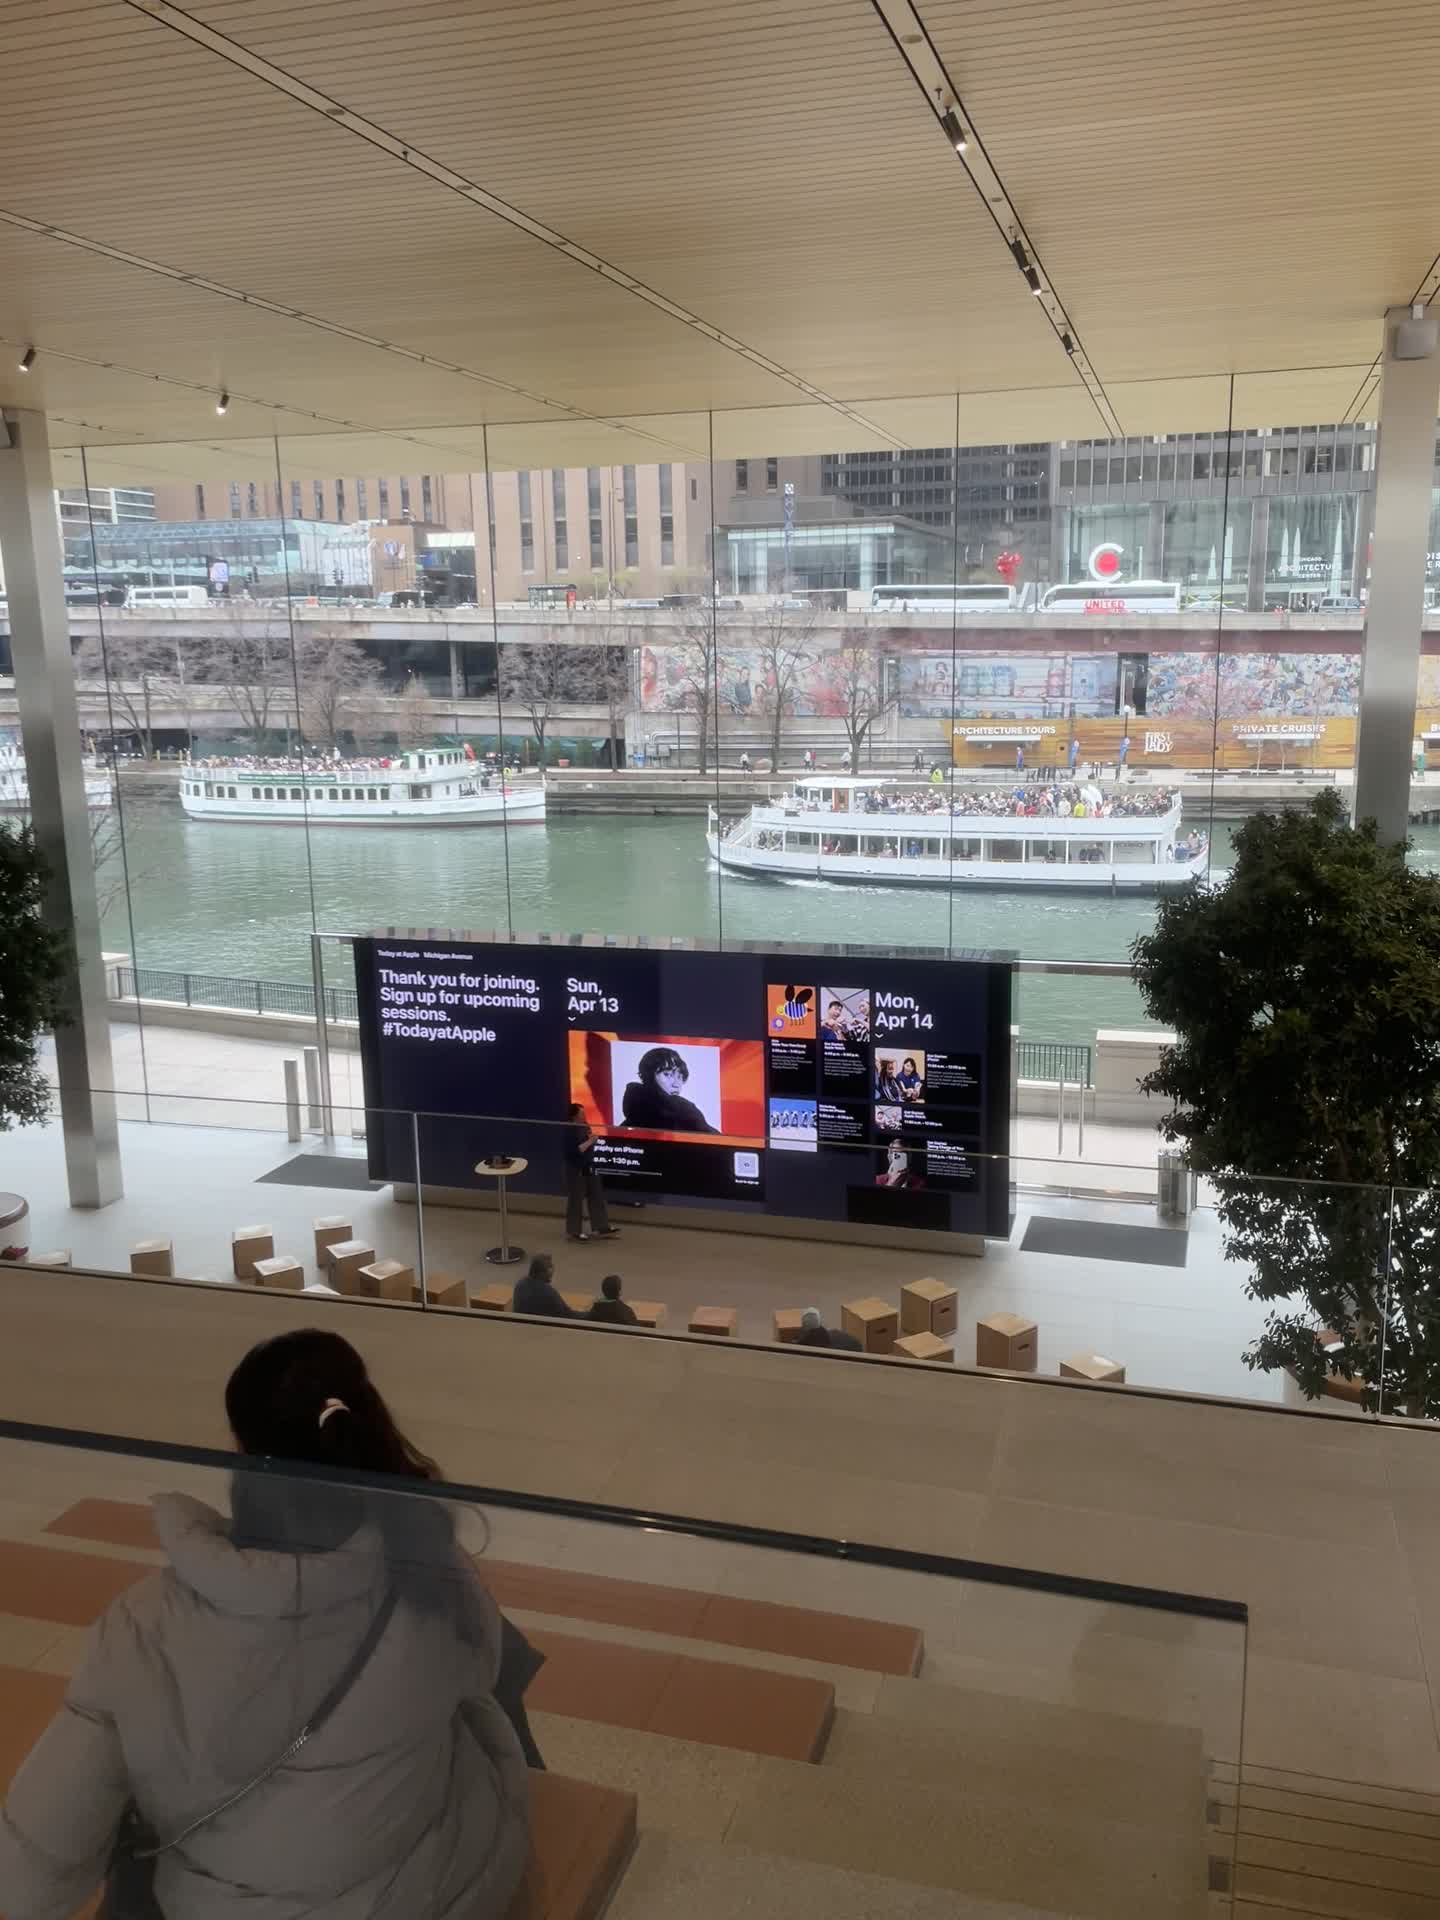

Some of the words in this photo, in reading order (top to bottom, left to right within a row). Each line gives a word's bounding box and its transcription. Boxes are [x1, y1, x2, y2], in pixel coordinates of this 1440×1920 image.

[1278, 563, 1334, 573] ARCHITECTU
[1085, 599, 1126, 609] UNITED
[953, 727, 1023, 735] ARCHITECTURE
[1026, 726, 1056, 735] TOURS
[1145, 731, 1171, 742] FIRST
[1232, 724, 1278, 733] PRIVATE
[1281, 724, 1327, 733] CRUISES
[1144, 741, 1174, 753] LADY
[379, 969, 427, 985] Thank
[428, 975, 457, 989] you
[459, 973, 481, 988] for
[483, 974, 540, 994] joining.
[567, 977, 603, 996] Sun,
[380, 987, 414, 1004] Sign
[417, 992, 437, 1006] up
[439, 990, 461, 1004] for
[463, 993, 540, 1012] upcoming
[567, 996, 597, 1014] Apr
[599, 997, 619, 1013] 13
[875, 991, 920, 1012] Mon,
[381, 1006, 451, 1022] sessions.
[875, 1011, 908, 1030] Apr
[911, 1013, 934, 1030] 14
[383, 1022, 496, 1044] #TodayatApple
